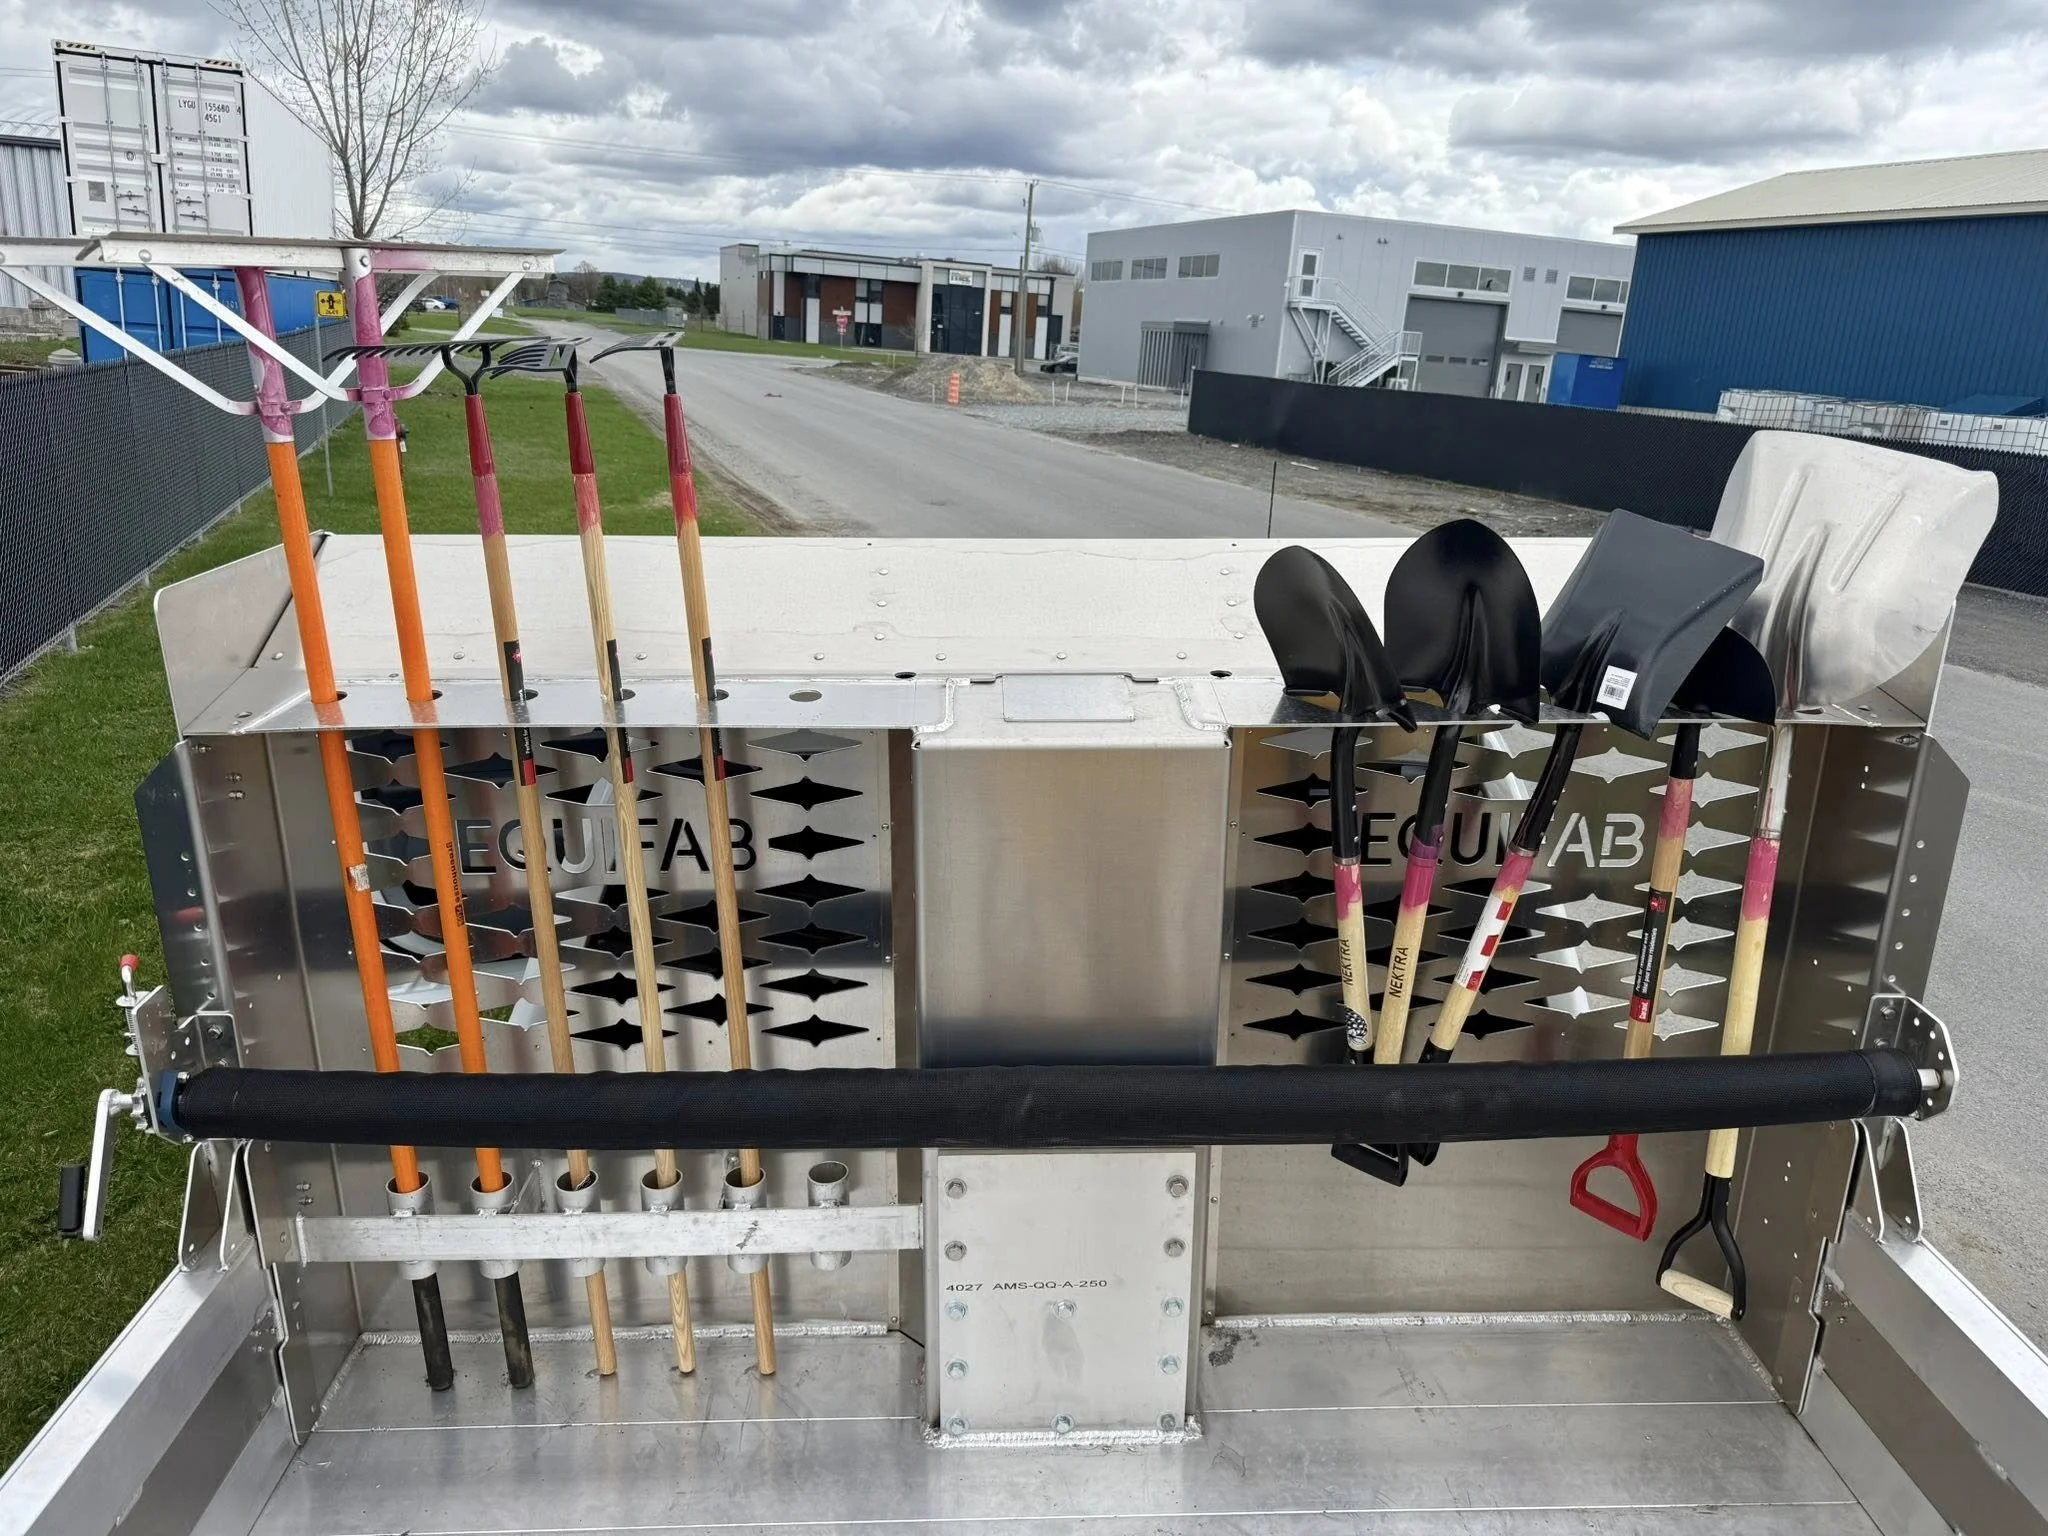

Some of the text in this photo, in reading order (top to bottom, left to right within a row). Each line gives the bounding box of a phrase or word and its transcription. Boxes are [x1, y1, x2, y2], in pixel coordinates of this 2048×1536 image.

[178, 99, 196, 109] LYGU
[205, 102, 230, 113] 155680
[205, 113, 221, 123] 45G1
[1360, 812, 1645, 868] EUIAB
[446, 841, 460, 903] greenhouse
[1341, 939, 1354, 986] NEKTRA
[1389, 947, 1409, 998] NEKTRA
[946, 1280, 1108, 1292] 4027 AMS-QQ-A-250
